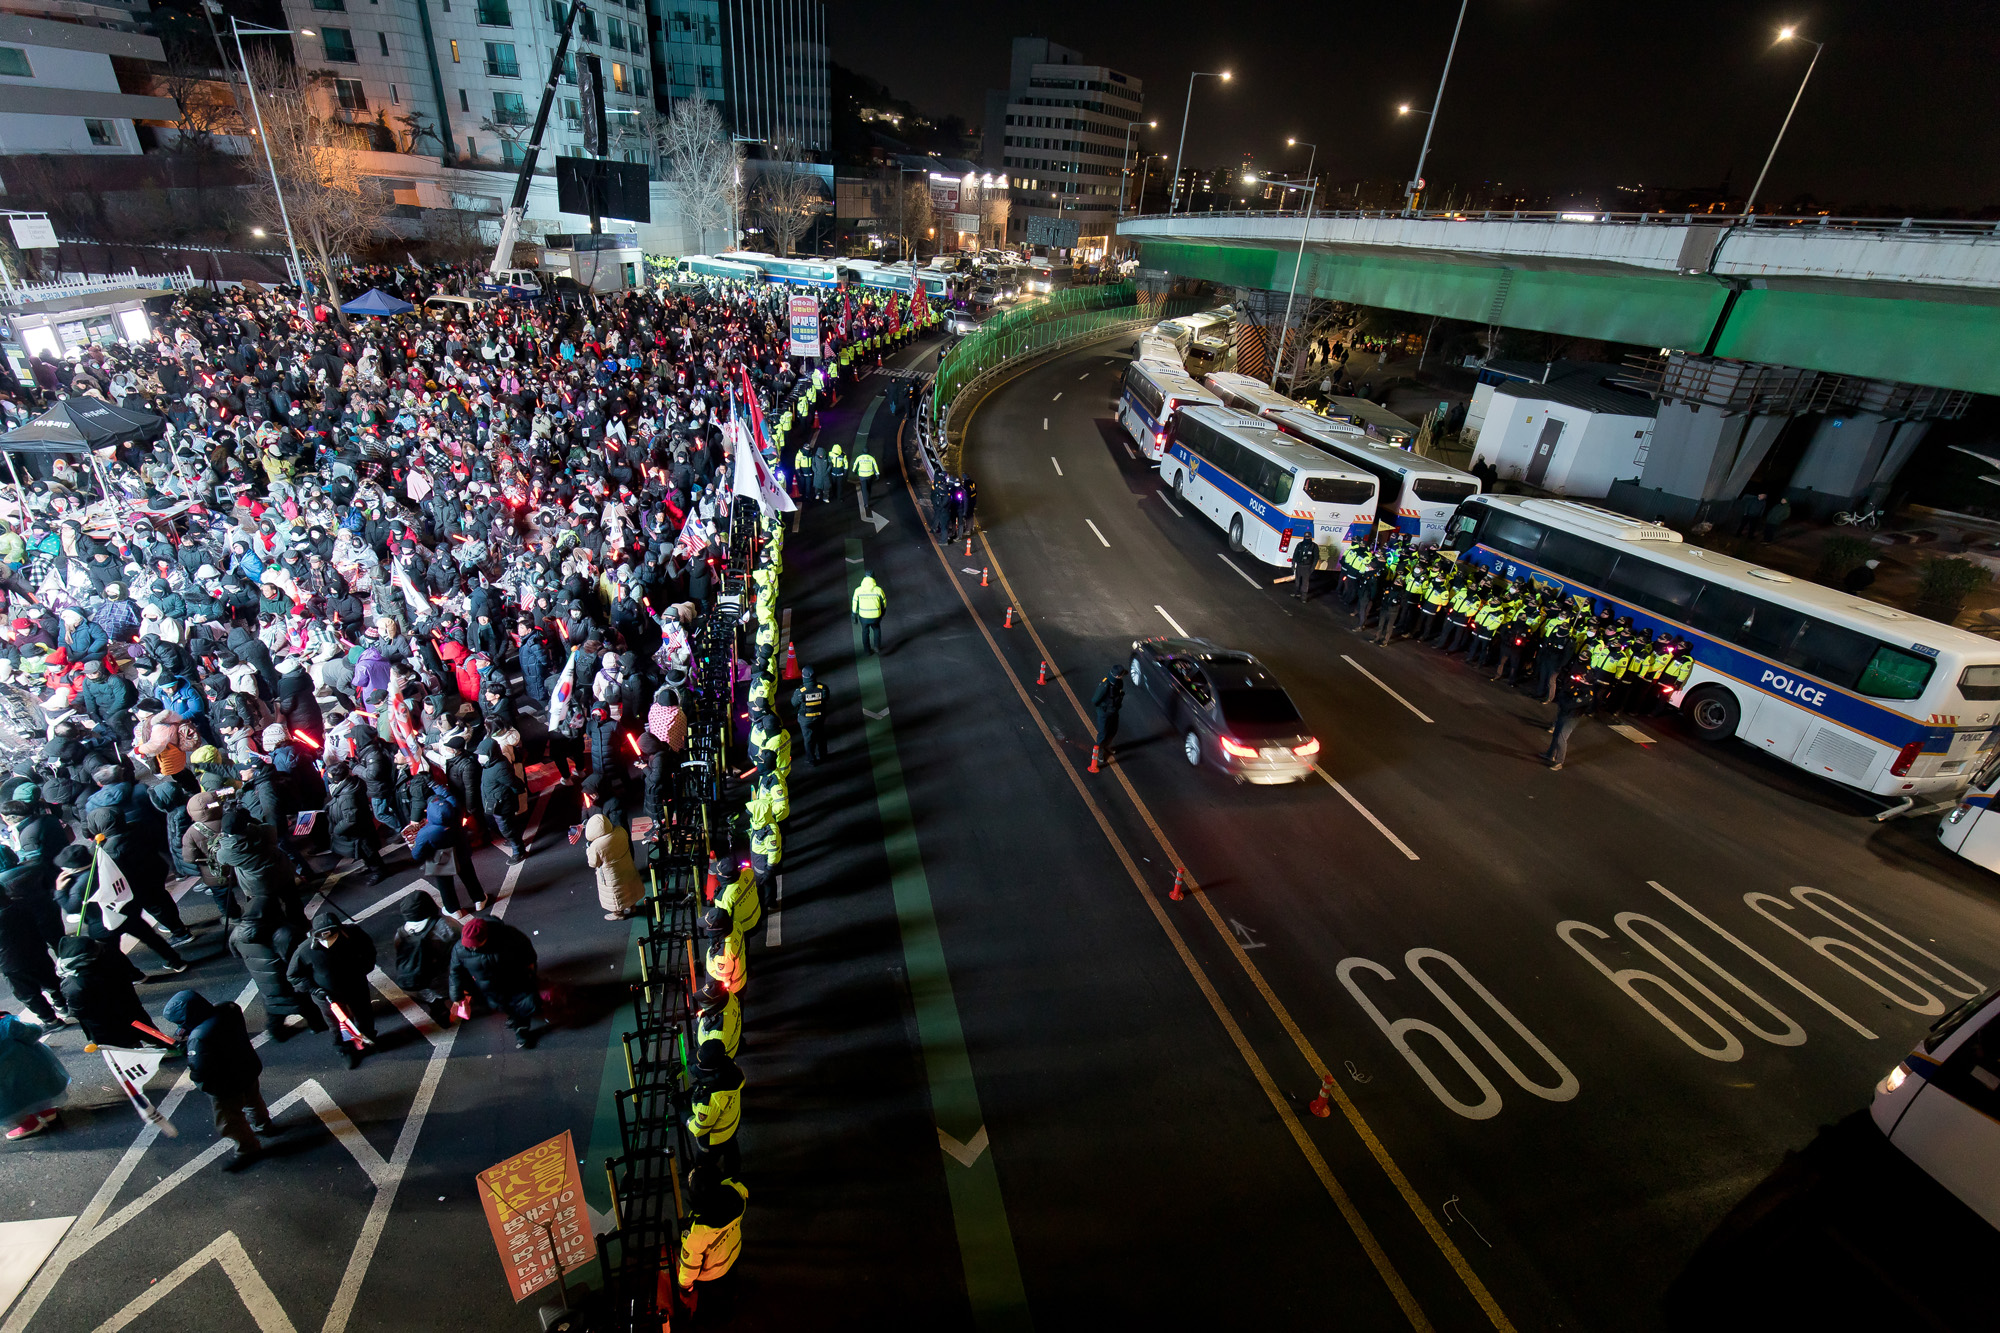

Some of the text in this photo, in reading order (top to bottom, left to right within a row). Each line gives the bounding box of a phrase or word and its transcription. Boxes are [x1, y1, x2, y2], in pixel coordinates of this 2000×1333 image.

[792, 316, 817, 327] 이재명
[1249, 498, 1266, 517] POLICE
[1320, 525, 1342, 533] POLICE
[1494, 559, 1517, 577] 경찰
[1760, 669, 1827, 707] POLICE
[1959, 733, 1984, 742] POLICE
[1743, 886, 1988, 1016] 60
[1556, 911, 1808, 1062] 60
[1335, 947, 1580, 1120] 60
